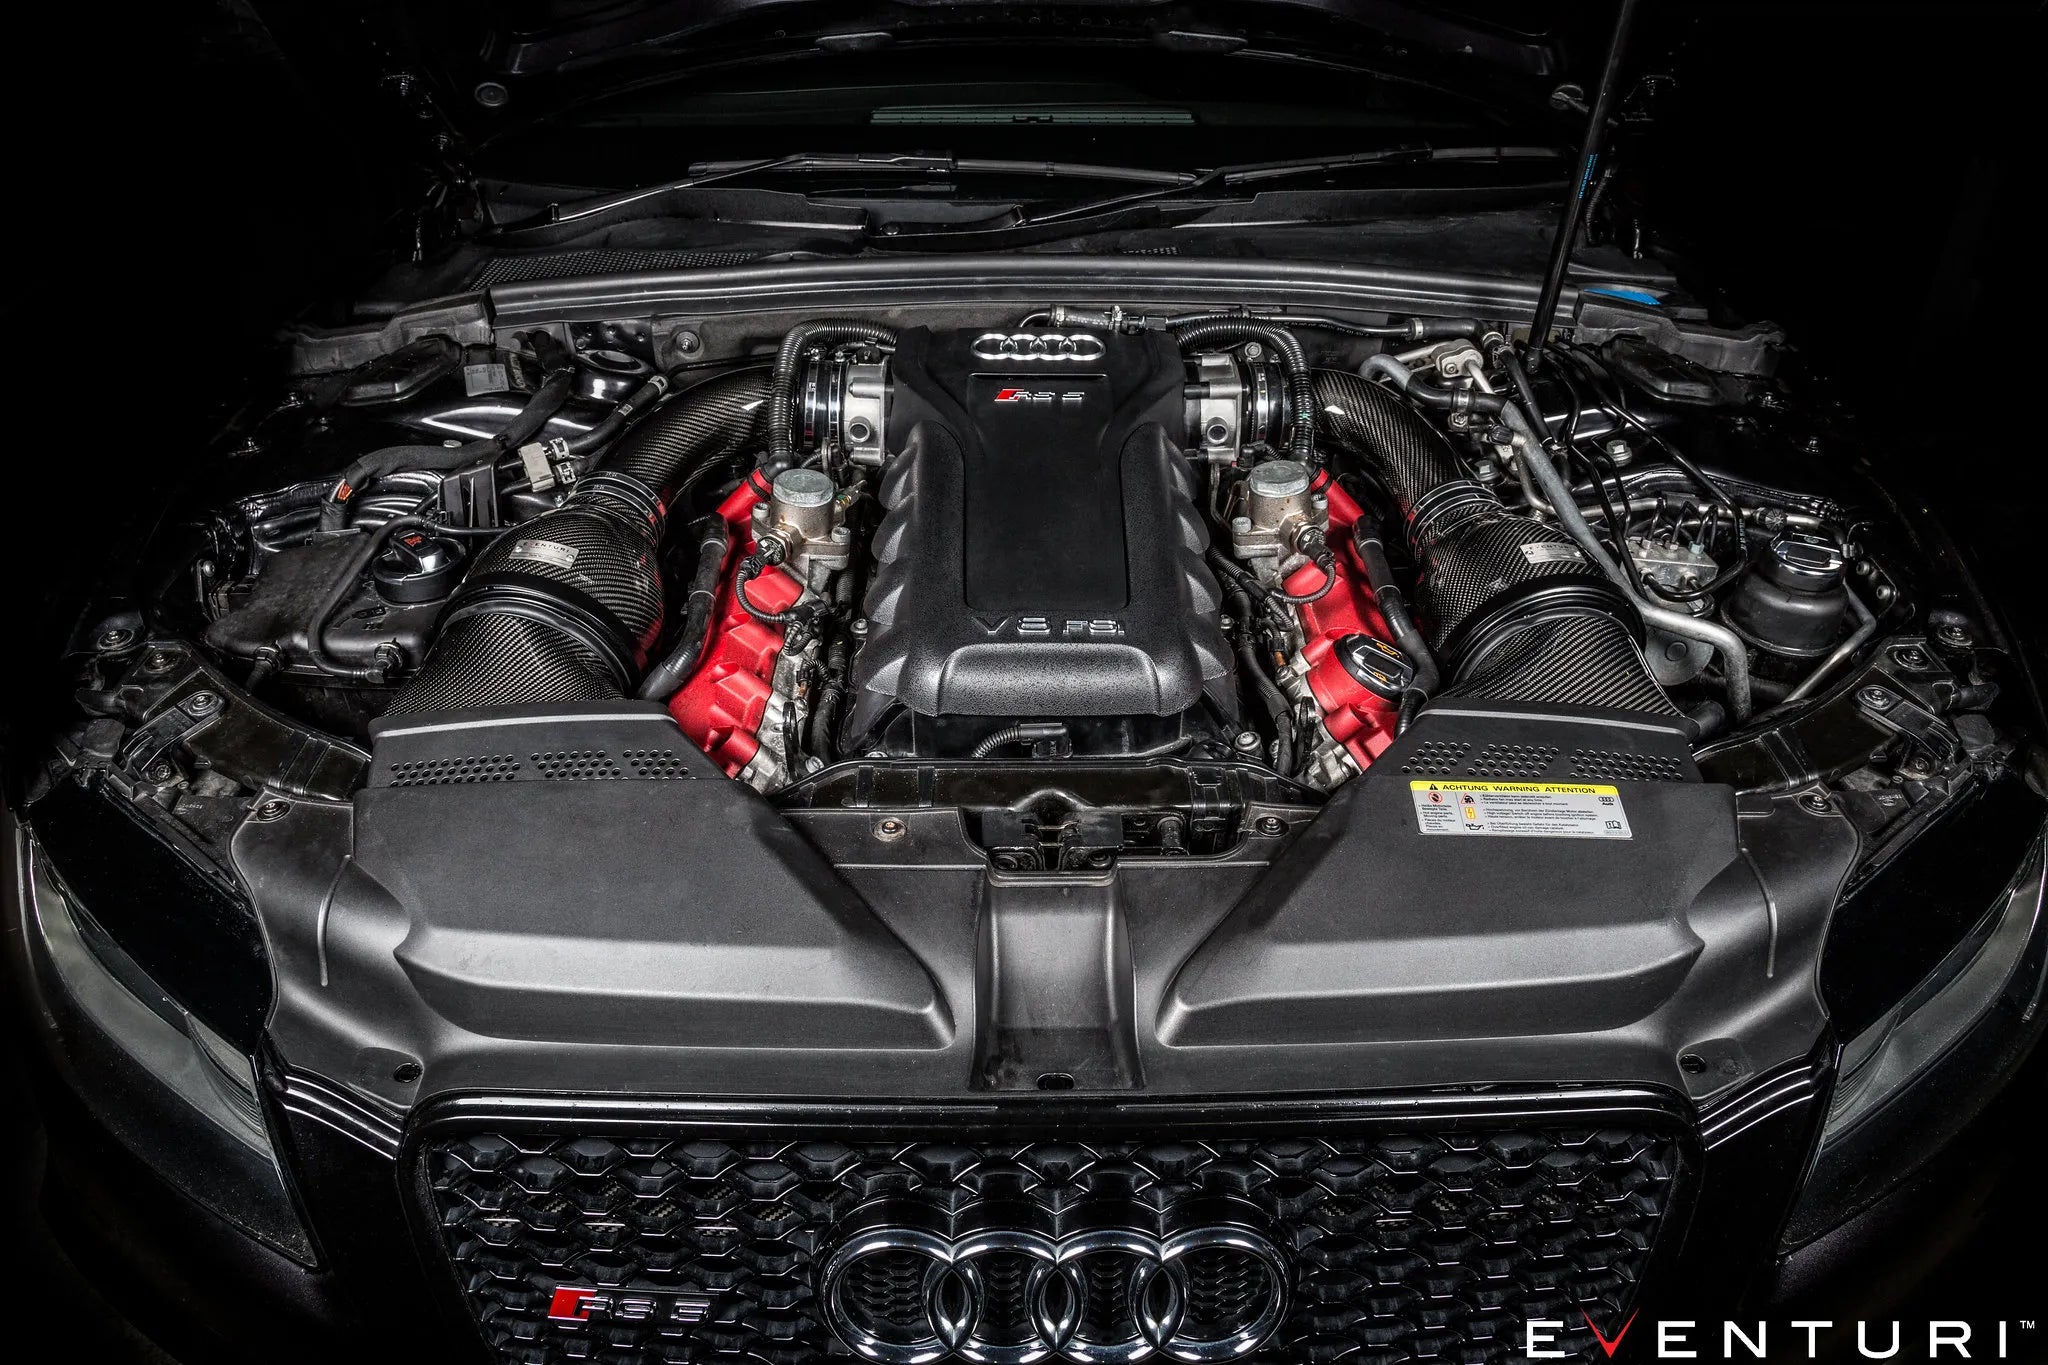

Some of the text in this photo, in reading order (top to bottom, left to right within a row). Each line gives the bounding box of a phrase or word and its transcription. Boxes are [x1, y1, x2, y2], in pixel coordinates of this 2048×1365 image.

[1442, 784, 1596, 795] ACHTUNG WARNING ATTENTION
